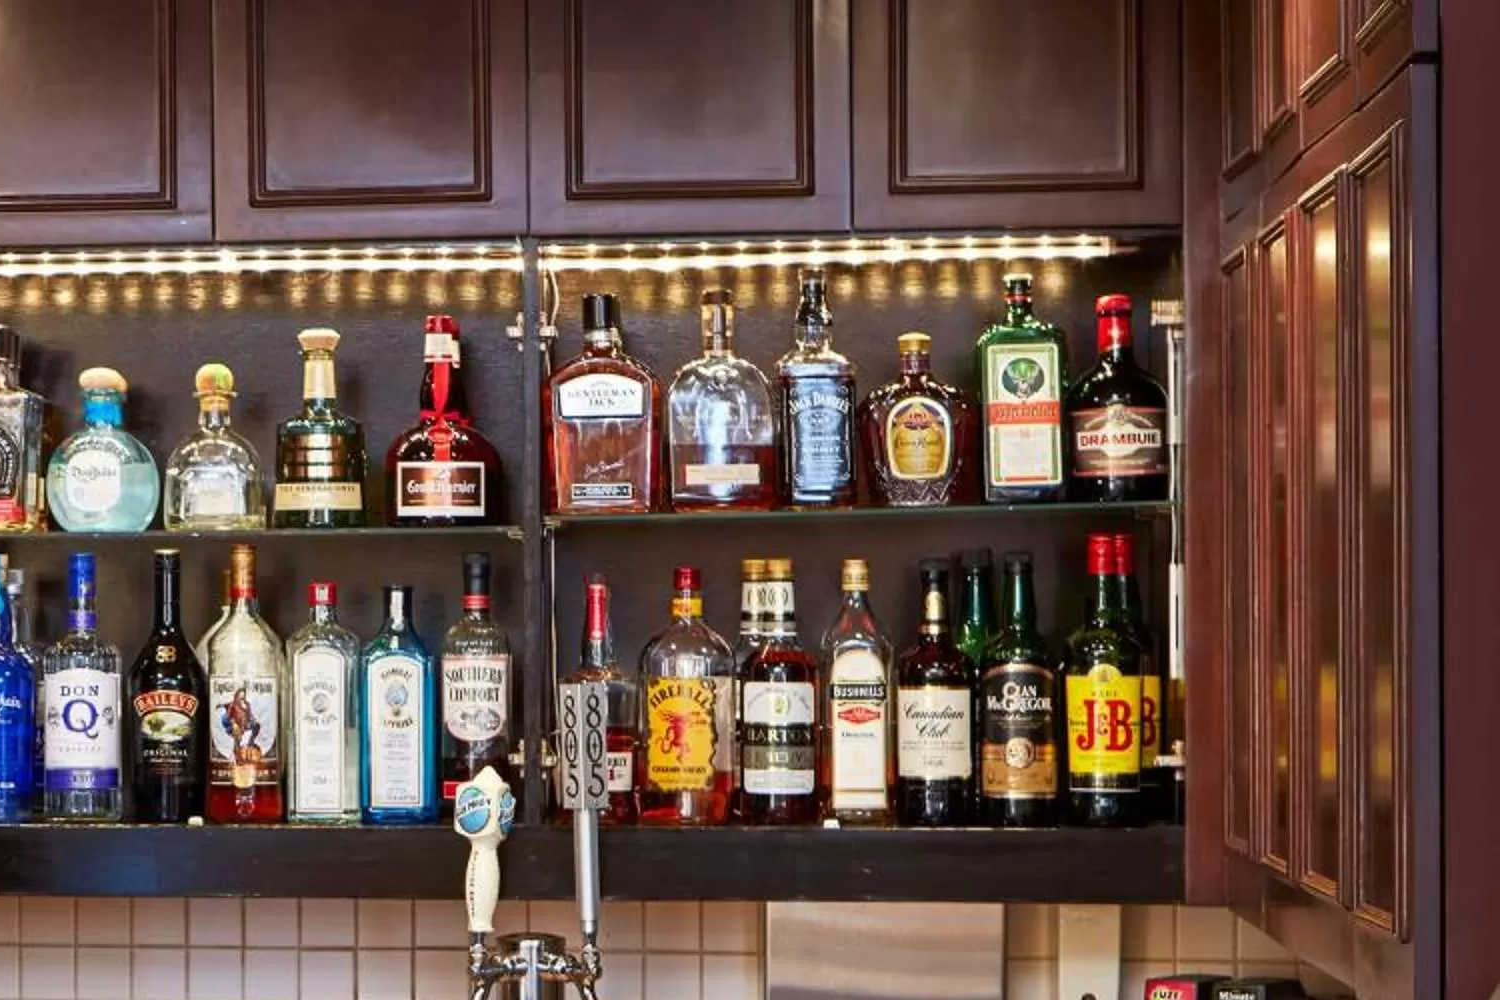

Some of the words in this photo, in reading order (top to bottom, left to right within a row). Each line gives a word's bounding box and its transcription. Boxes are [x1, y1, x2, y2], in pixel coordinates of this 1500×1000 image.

[1080, 432, 1158, 448] DRAMBUIE
[445, 665, 504, 686] SOUTHERN
[60, 686, 100, 698] DON
[449, 687, 500, 703] COMFORT
[833, 685, 884, 697] BUSHMILLS
[137, 690, 195, 713] BAILEYS
[61, 699, 100, 739] Q
[904, 703, 965, 720] Canadian
[915, 722, 951, 738] Club
[1218, 990, 1255, 1000] Minute
